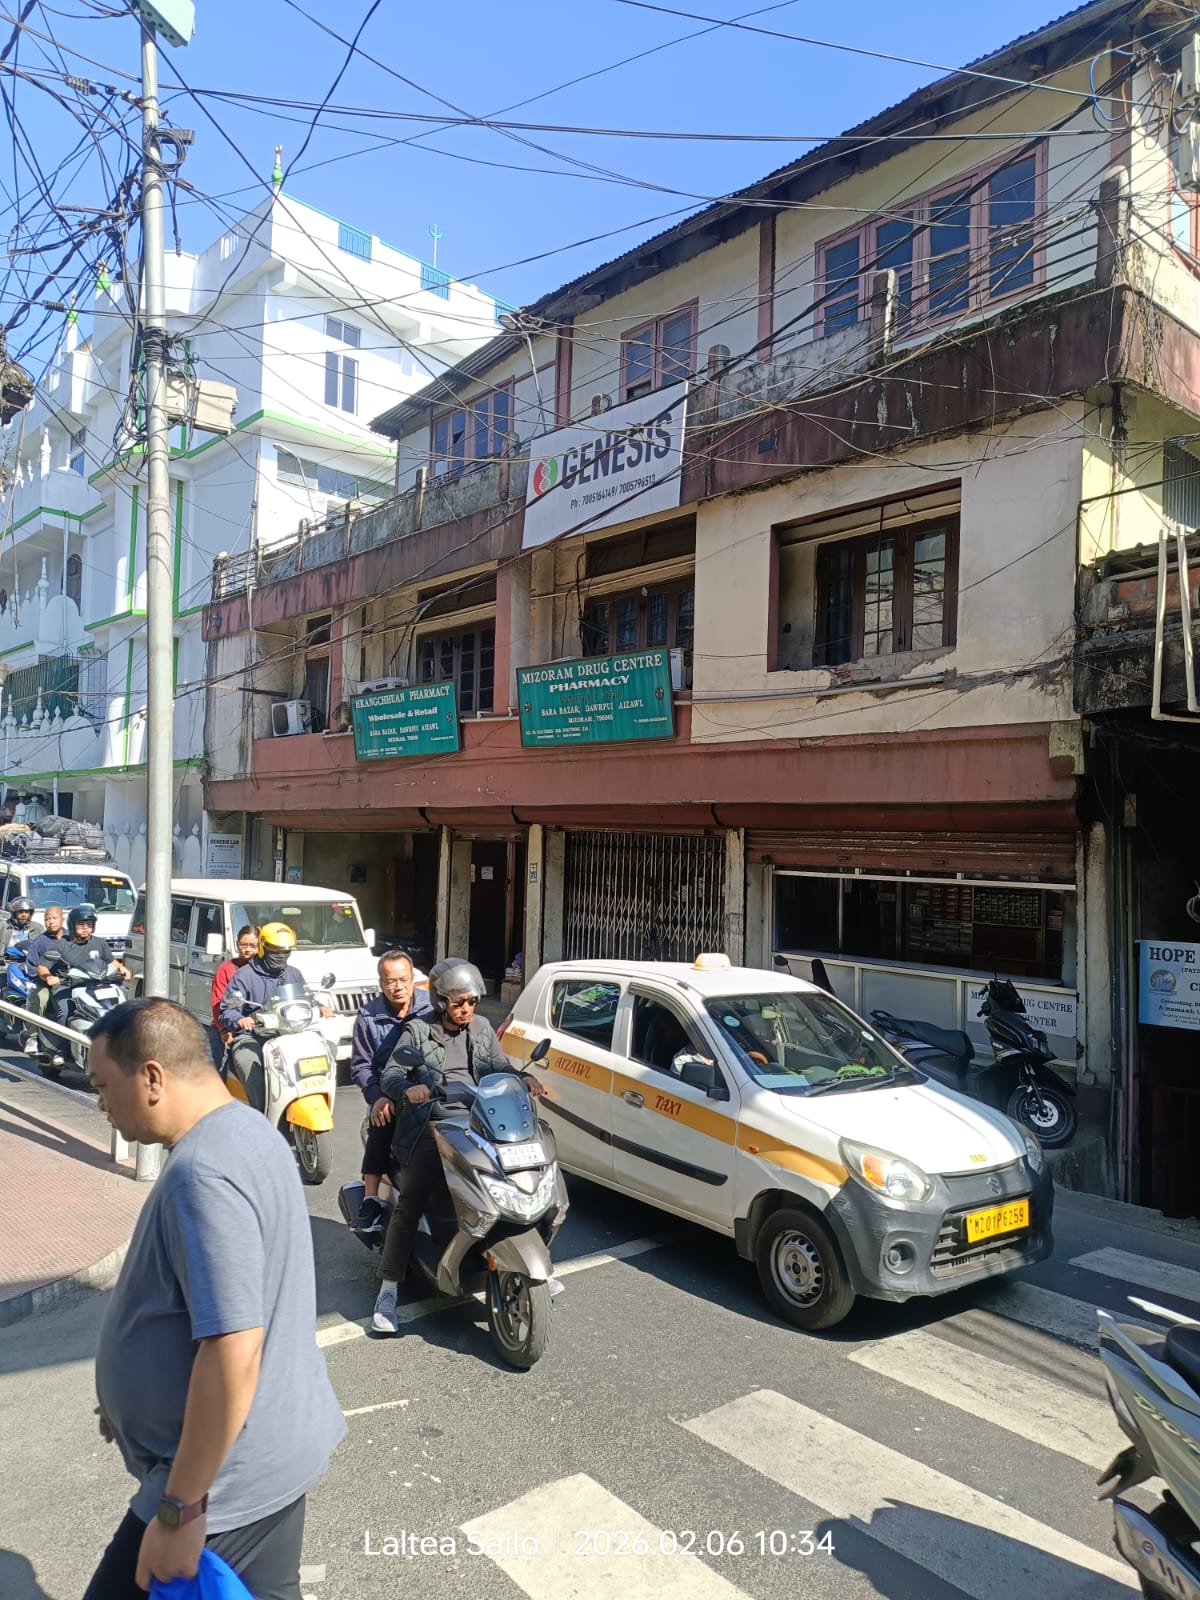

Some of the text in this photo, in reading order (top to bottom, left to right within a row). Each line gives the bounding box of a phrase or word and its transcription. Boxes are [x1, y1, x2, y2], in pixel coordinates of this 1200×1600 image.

[561, 413, 673, 490] GENESIS
[522, 654, 662, 684] MIZORAM DRUG CENTRE
[409, 685, 450, 701] PHARMACY
[549, 675, 630, 693] PHARMACY
[368, 711, 406, 722] Wholesale
[414, 707, 438, 716] Retail
[541, 707, 557, 717] BARA
[619, 699, 644, 710] AIZAWL
[1149, 946, 1196, 964] HOPE
[1037, 1000, 1073, 1013] CENTRE
[554, 1056, 592, 1080] AIZAWL
[656, 1094, 682, 1116] TAXI
